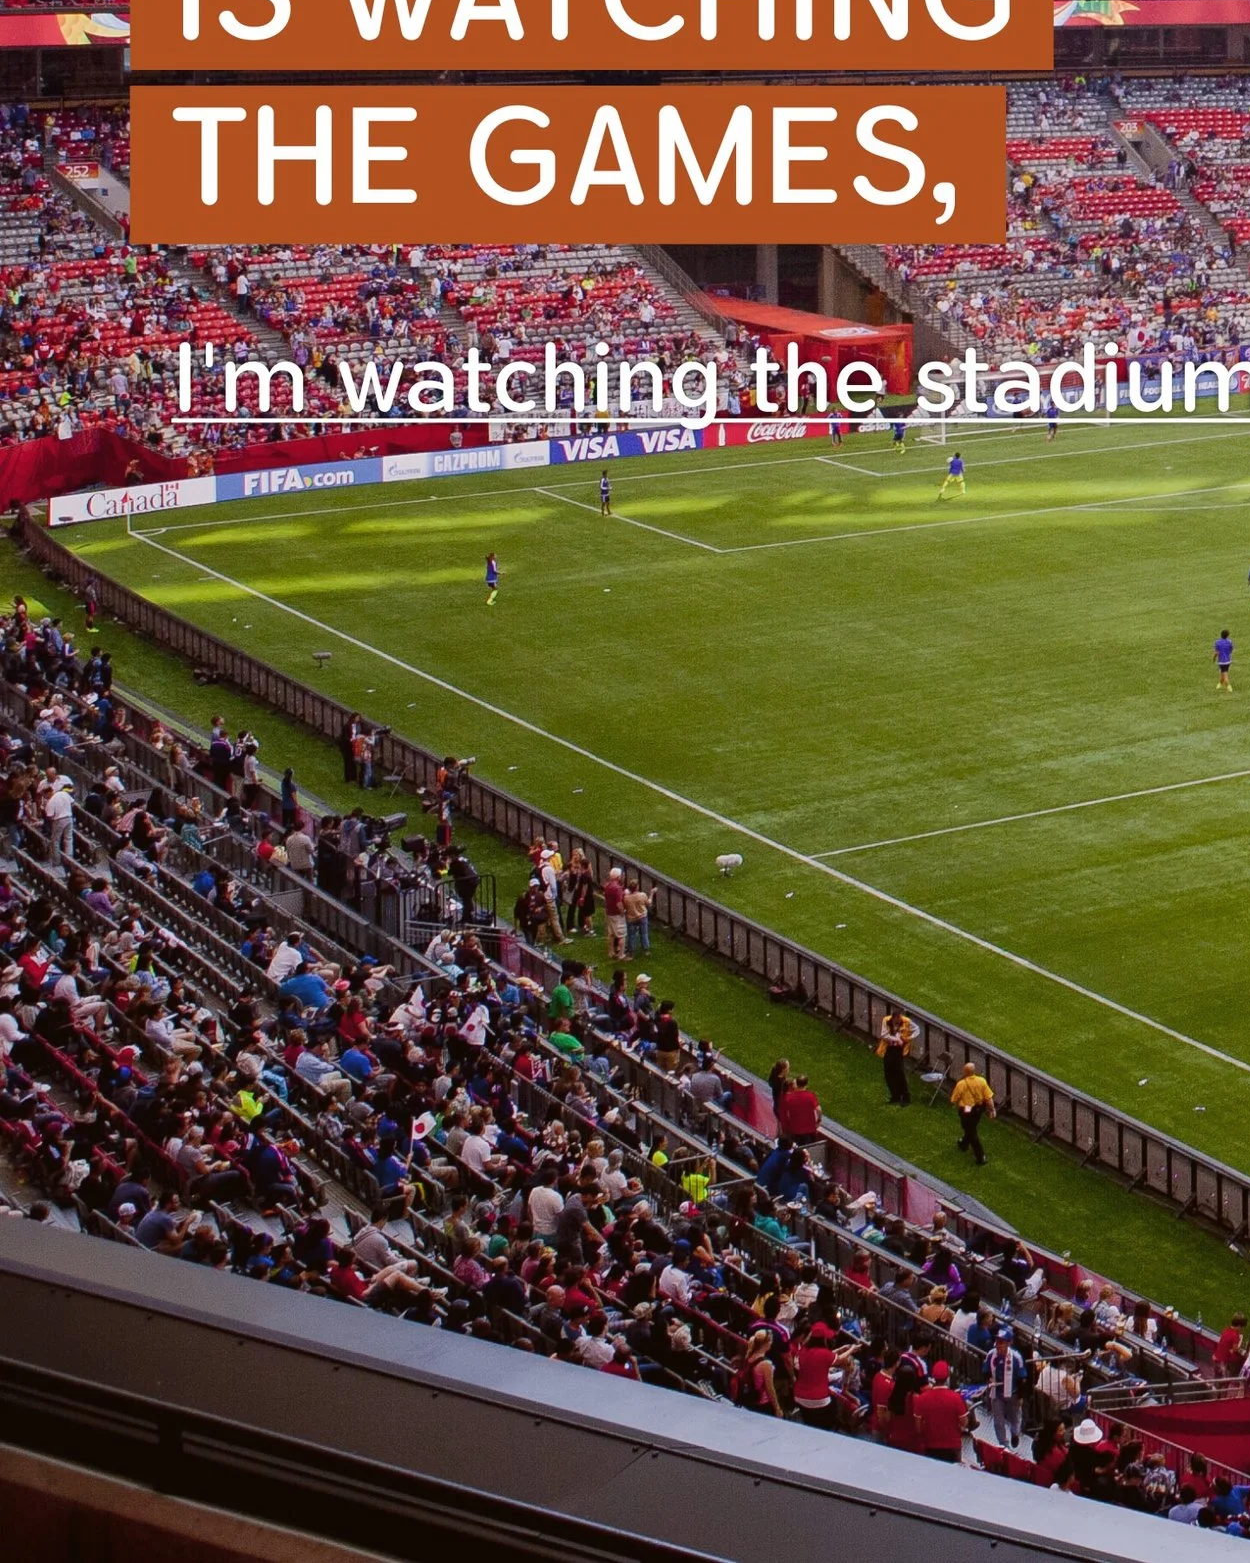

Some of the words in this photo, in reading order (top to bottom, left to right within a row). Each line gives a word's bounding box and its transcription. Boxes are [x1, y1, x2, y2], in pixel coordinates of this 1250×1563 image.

[1119, 122, 1138, 133] 203
[65, 165, 89, 178] 252
[558, 435, 620, 462] VISA
[637, 429, 697, 454] VISA
[434, 449, 501, 473] GAZPROM
[244, 468, 355, 496] FIFA.com
[87, 484, 178, 517] Canada
